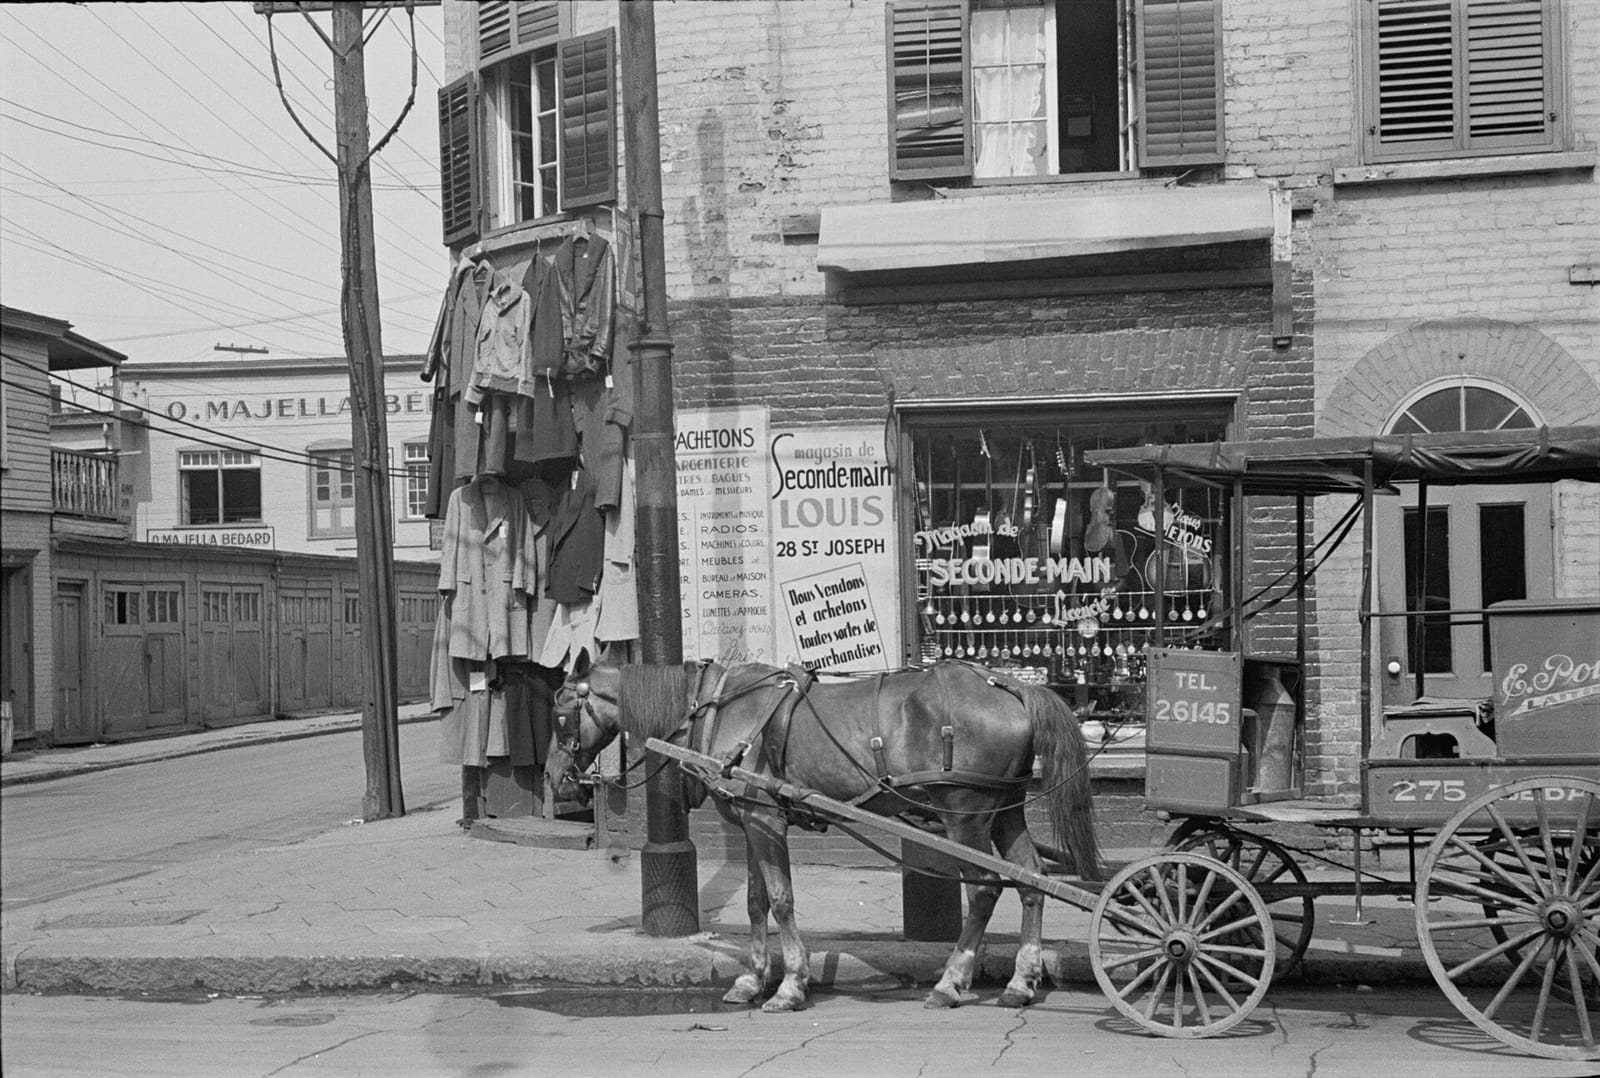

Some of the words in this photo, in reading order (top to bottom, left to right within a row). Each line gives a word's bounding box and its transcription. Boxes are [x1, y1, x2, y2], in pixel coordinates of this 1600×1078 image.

[167, 400, 200, 420] O.
[208, 397, 353, 420] MAJELLA
[794, 444, 852, 465] magasin
[859, 441, 875, 457] de
[712, 472, 751, 484] BAGUES
[780, 496, 884, 529] LOUIS
[997, 517, 1018, 538] de
[222, 532, 271, 545] BEDARD
[776, 541, 797, 557] 28
[824, 538, 885, 556] JOSEPH
[702, 556, 744, 566] MEUBLES
[702, 574, 729, 583] BUREAU
[737, 572, 766, 581] MAISON
[930, 557, 1111, 587] SECONDE-MAIN
[703, 607, 730, 617] LUNETTES
[795, 609, 807, 627] et
[813, 598, 867, 623] achetons
[799, 630, 833, 650] toutes
[833, 621, 861, 641] sortes
[863, 618, 877, 633] de
[802, 643, 881, 670] marchandises
[1175, 672, 1217, 690] TEL.
[1155, 699, 1230, 725] 26145
[1393, 780, 1466, 801] 275
